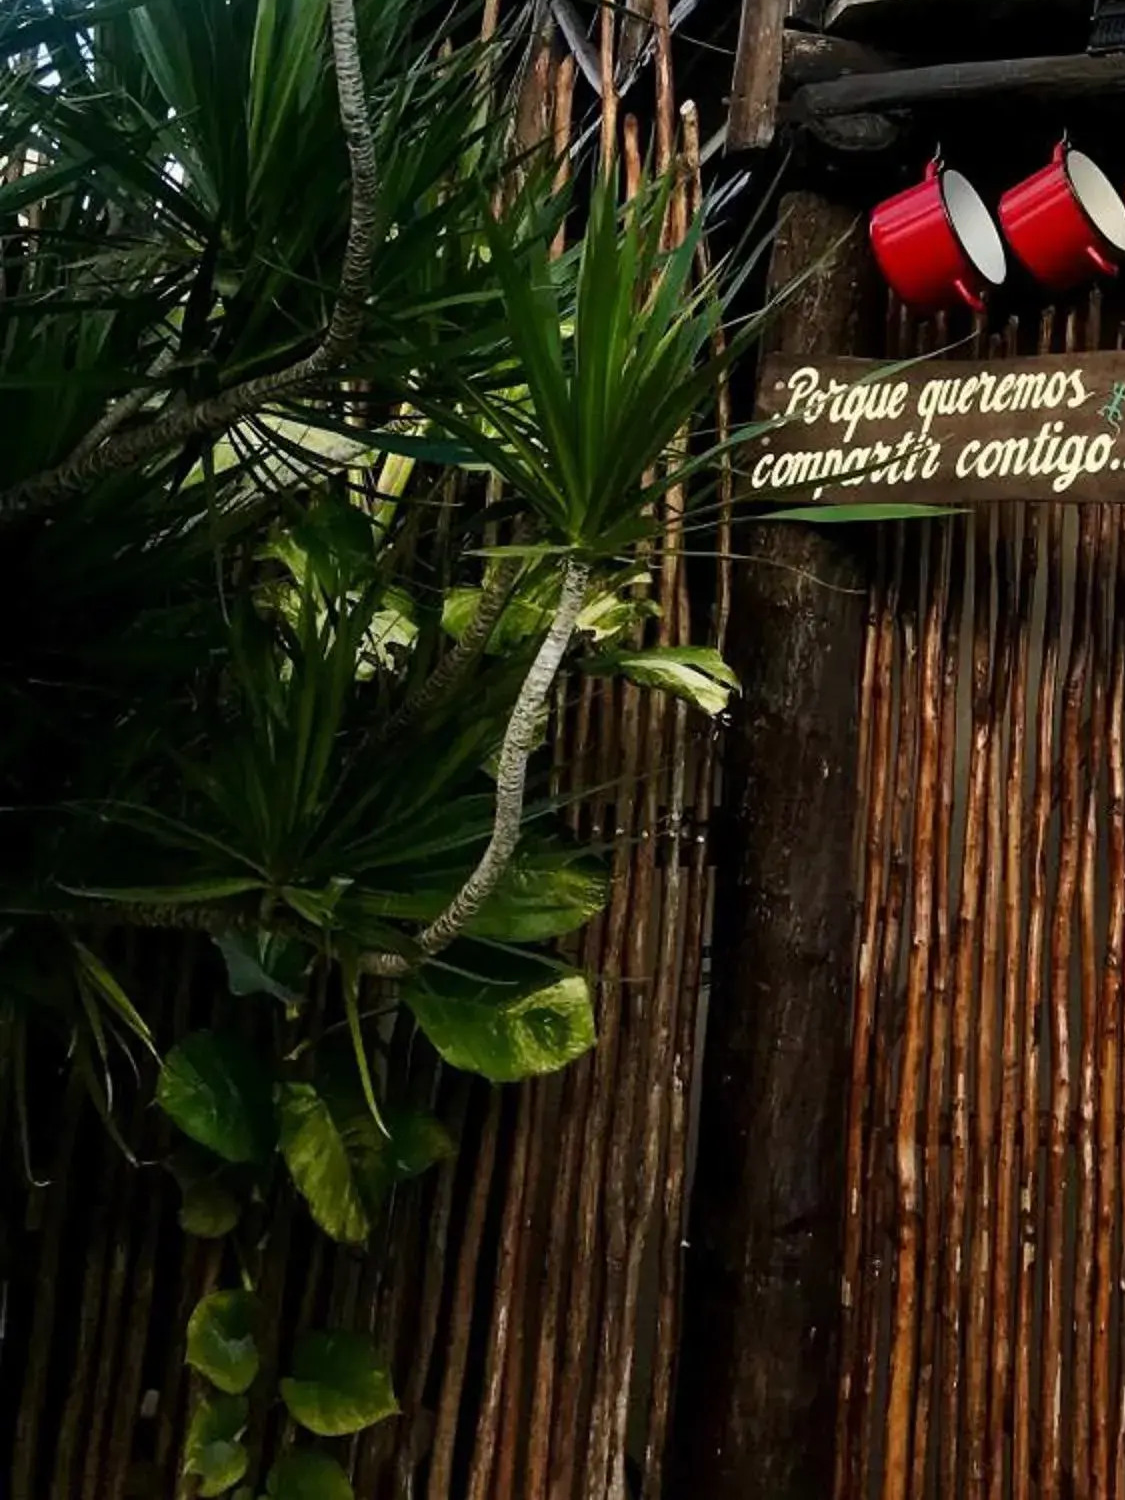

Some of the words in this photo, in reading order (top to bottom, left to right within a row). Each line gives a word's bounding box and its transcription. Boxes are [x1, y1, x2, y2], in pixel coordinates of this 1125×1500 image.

[772, 367, 909, 443] Porque
[917, 369, 1095, 442] queremos
[751, 431, 942, 500] compartir
